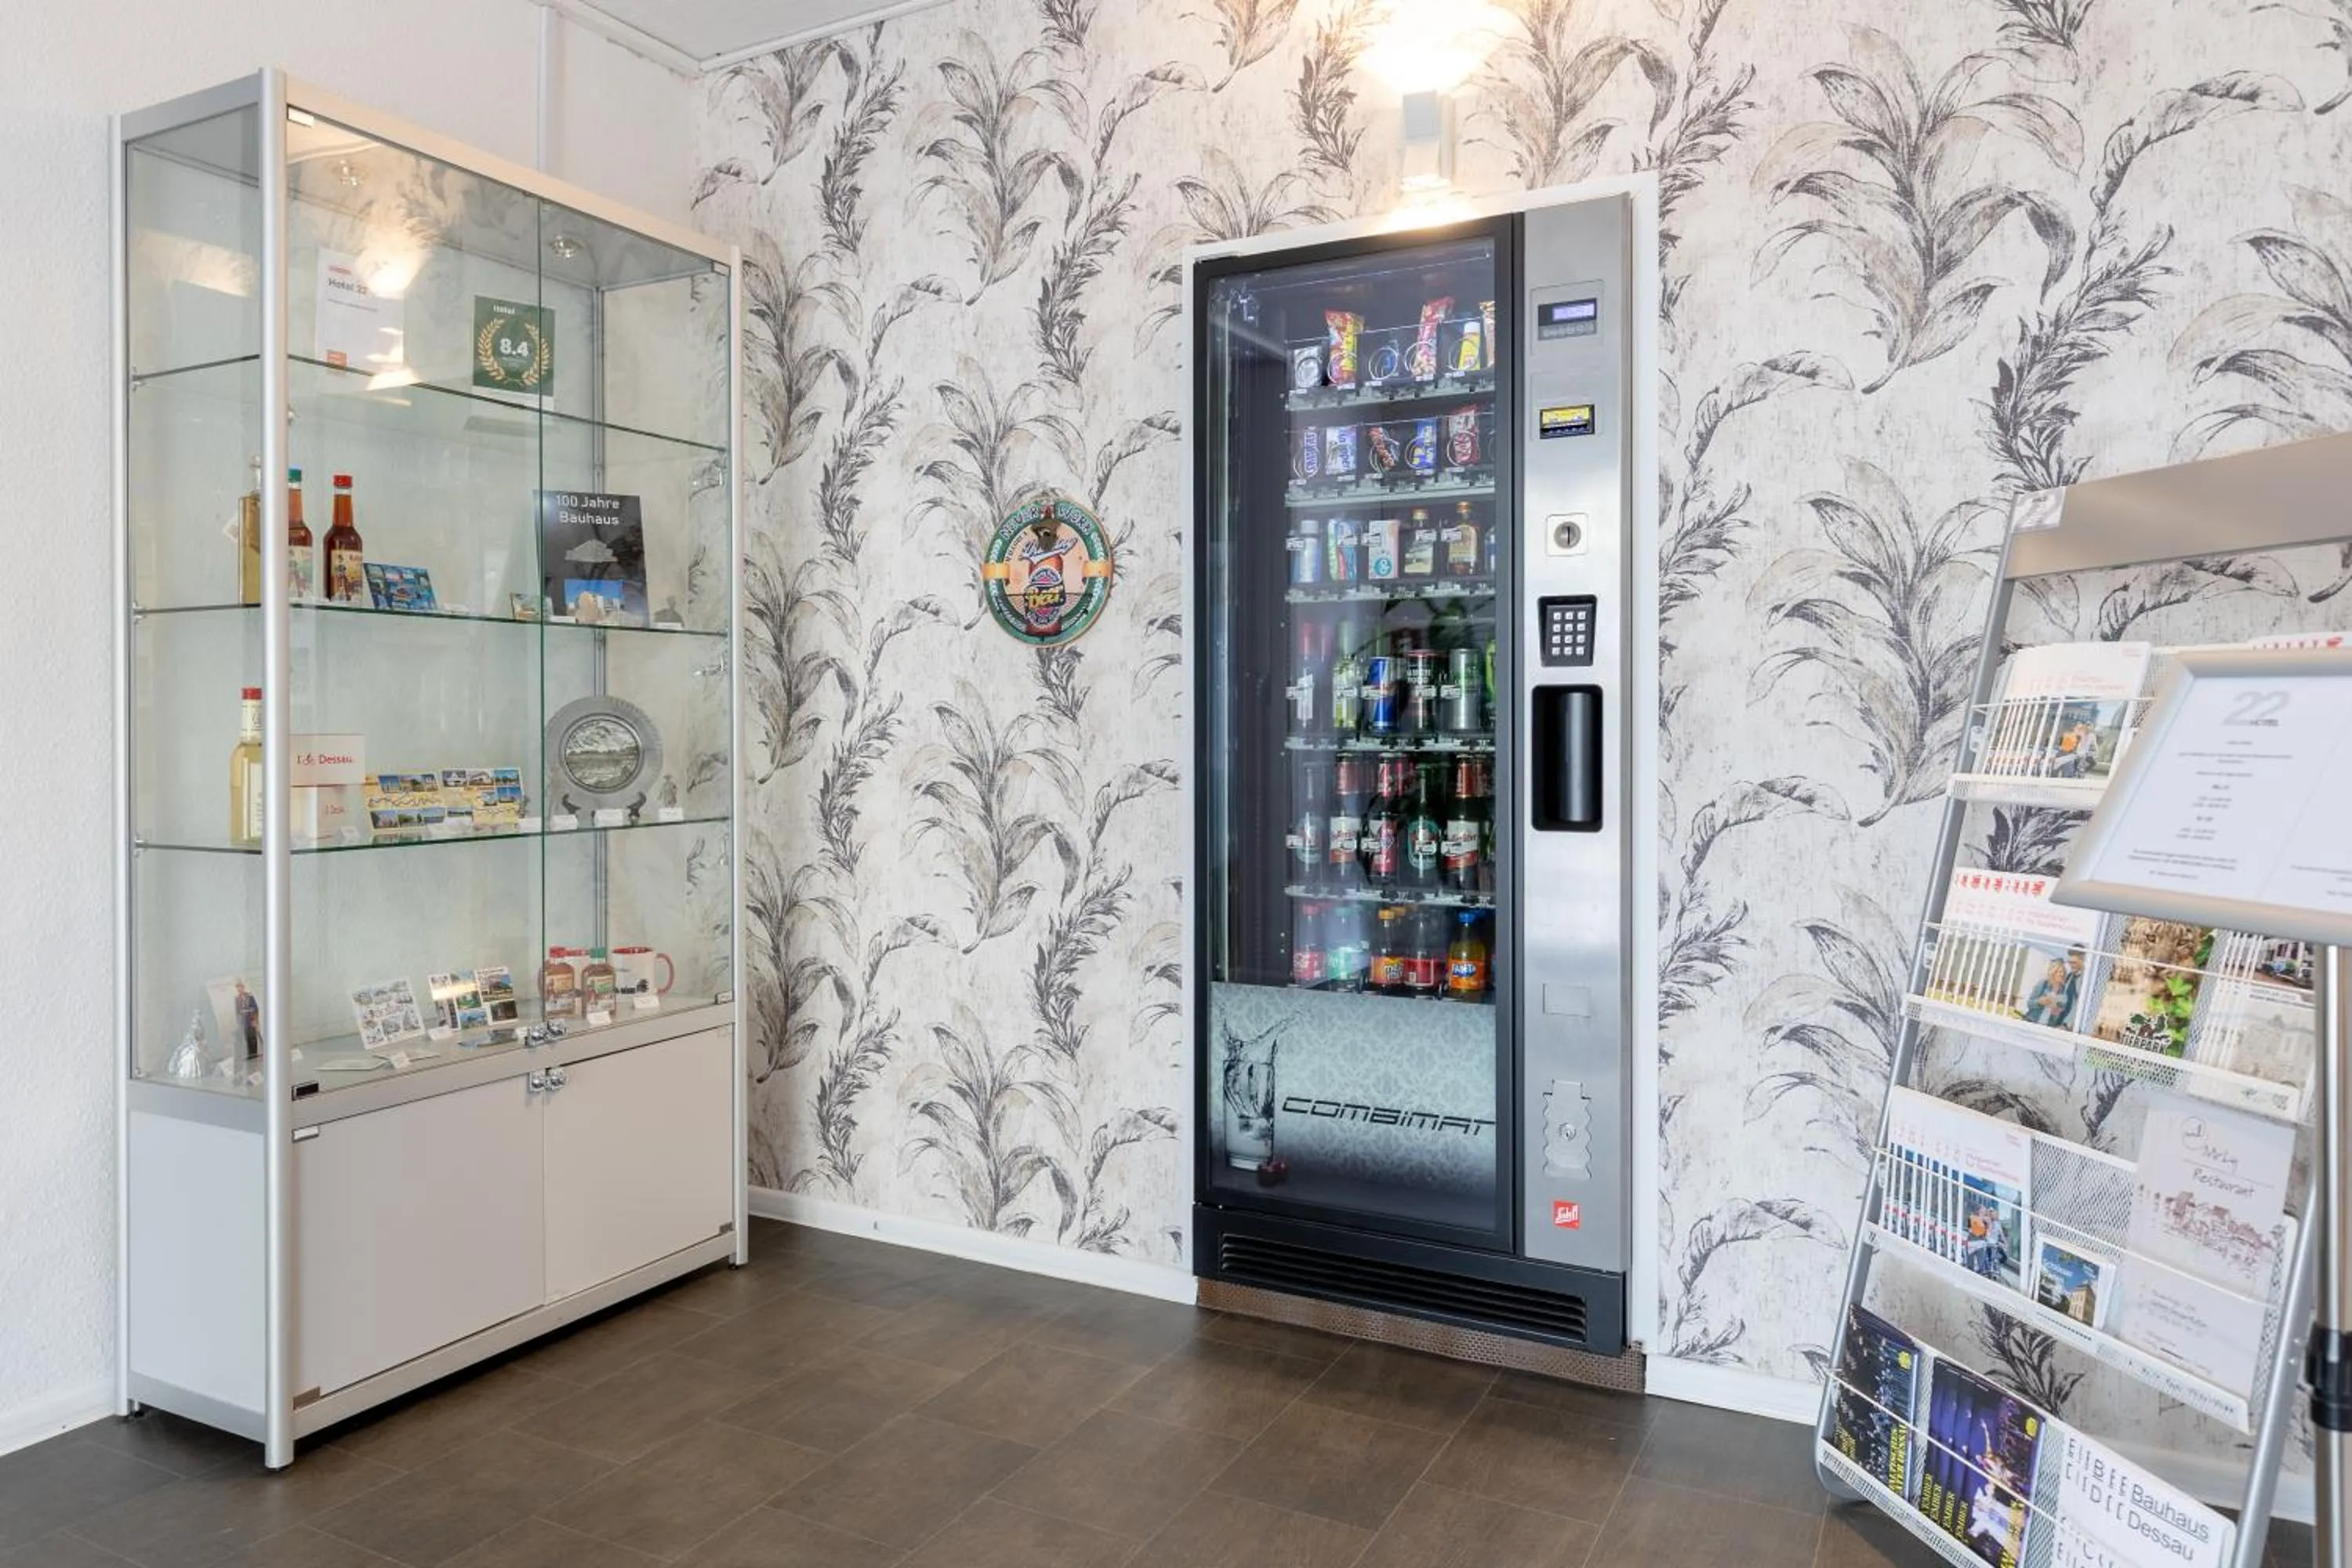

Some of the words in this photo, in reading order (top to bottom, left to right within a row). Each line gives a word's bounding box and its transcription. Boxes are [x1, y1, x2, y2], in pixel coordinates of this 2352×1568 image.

[499, 337, 529, 357] 8.4
[556, 495, 578, 507] 100
[580, 496, 620, 509] Jahre
[559, 510, 619, 525] Bauhaus
[2222, 690, 2291, 726] 22
[2132, 1483, 2209, 1541] Bauhaus
[2127, 1510, 2194, 1561] Dessau
